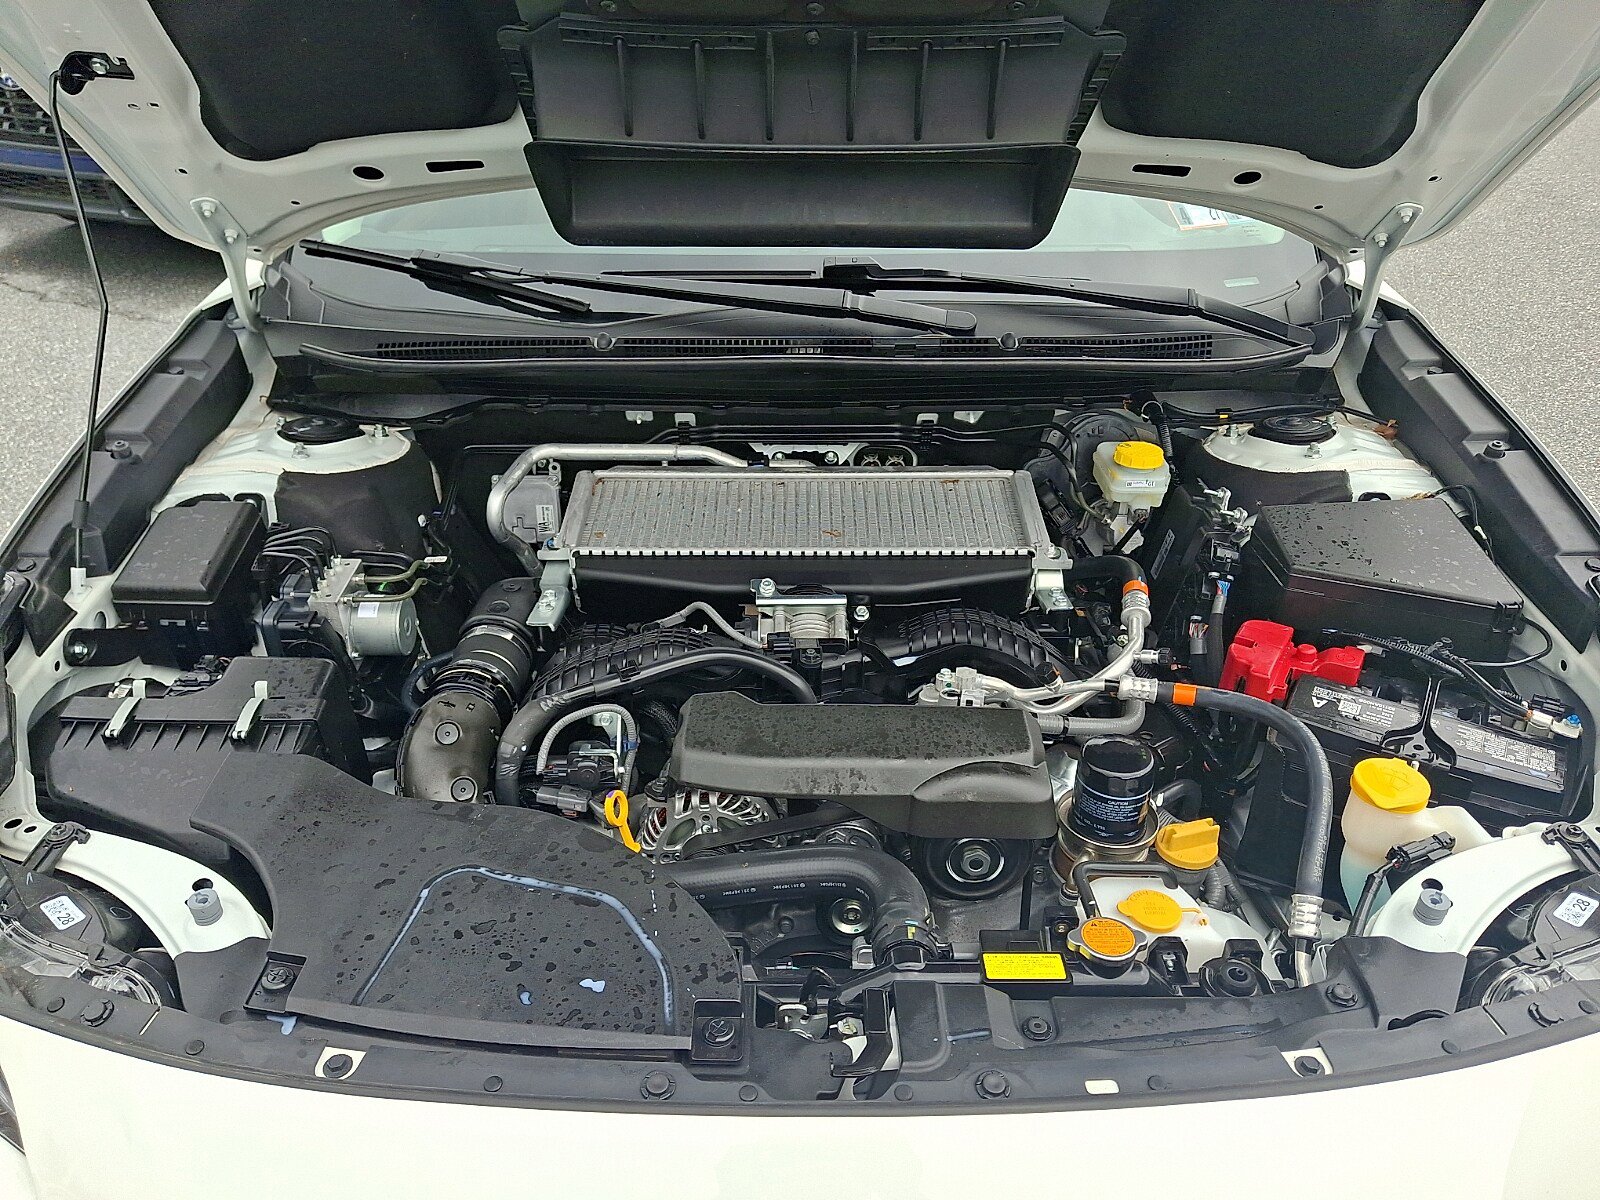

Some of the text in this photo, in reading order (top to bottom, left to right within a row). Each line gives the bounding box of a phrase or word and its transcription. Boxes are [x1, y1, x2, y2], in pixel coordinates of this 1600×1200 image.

[538, 521, 550, 533] WA
[1572, 898, 1591, 912] 28
[56, 912, 75, 926] 28
